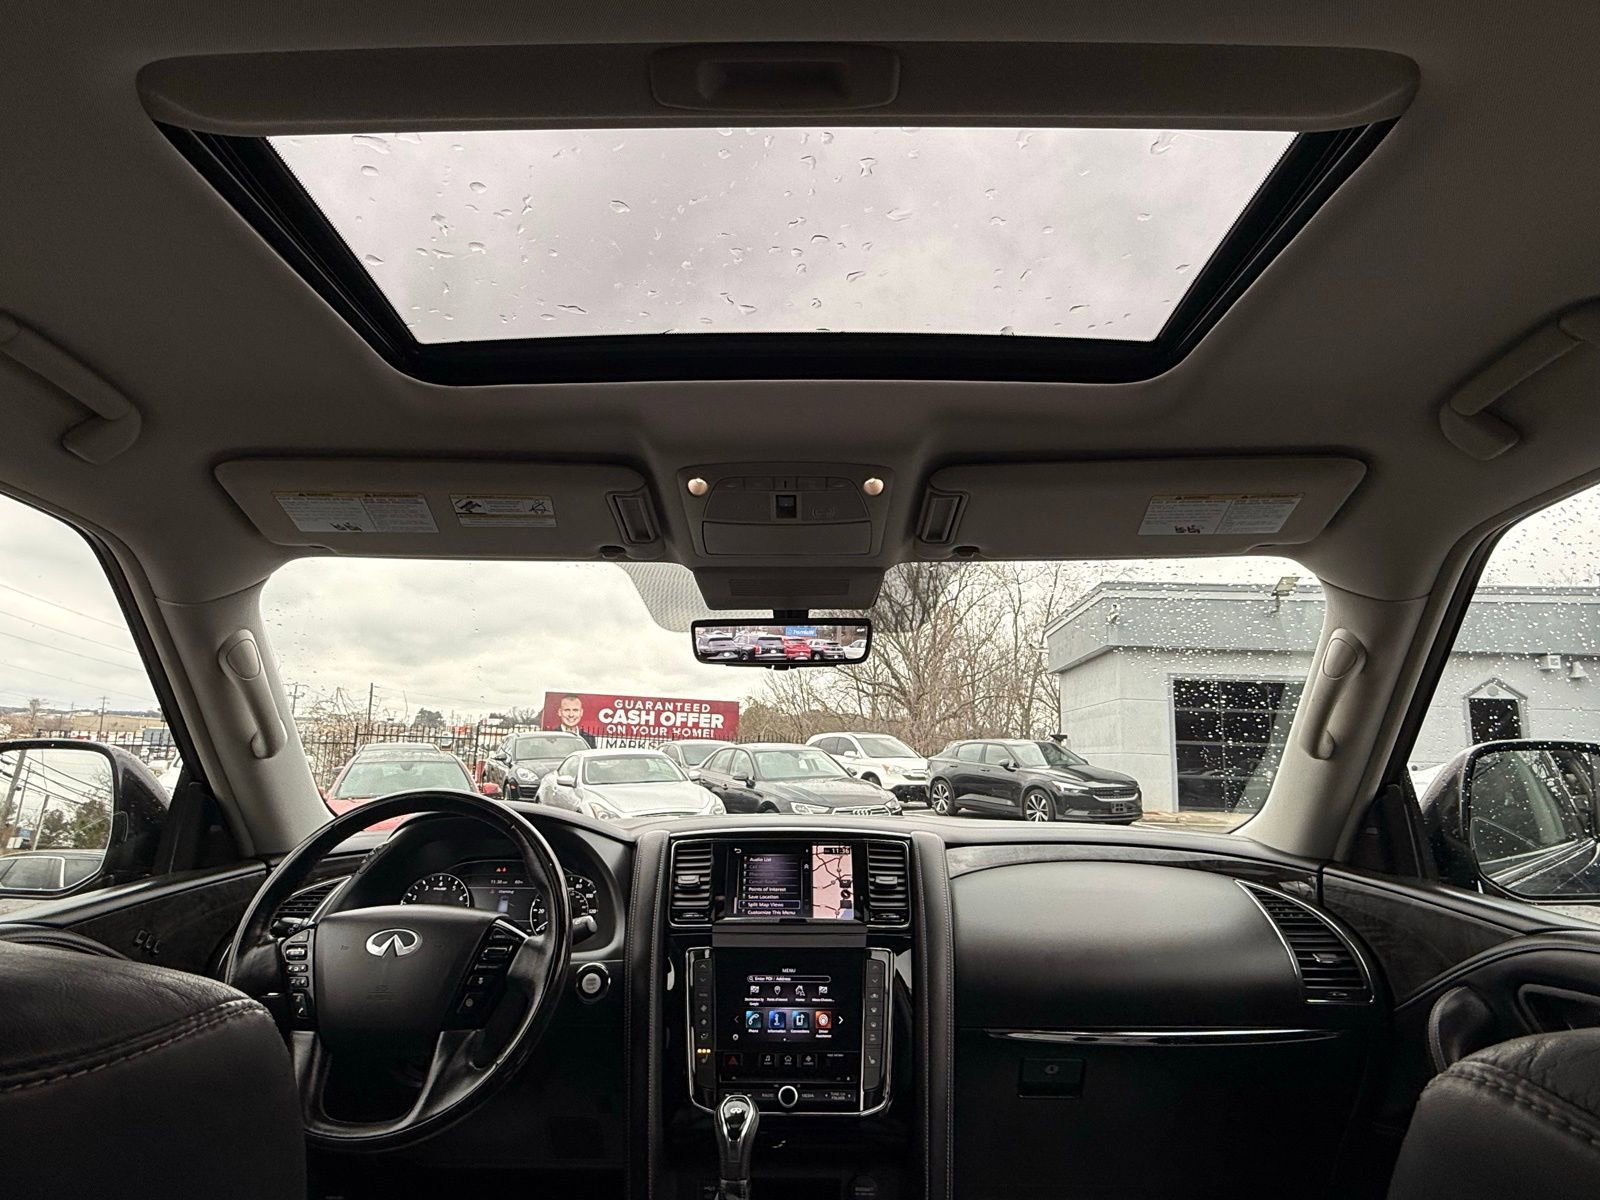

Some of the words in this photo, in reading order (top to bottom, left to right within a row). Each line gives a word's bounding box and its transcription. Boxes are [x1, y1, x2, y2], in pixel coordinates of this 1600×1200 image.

[614, 699, 711, 712] GUARANTEED
[598, 708, 656, 726] CASH
[660, 711, 725, 729] OFFER
[606, 725, 626, 735] ON
[631, 725, 668, 736] YOUR
[672, 728, 714, 738] HOME!
